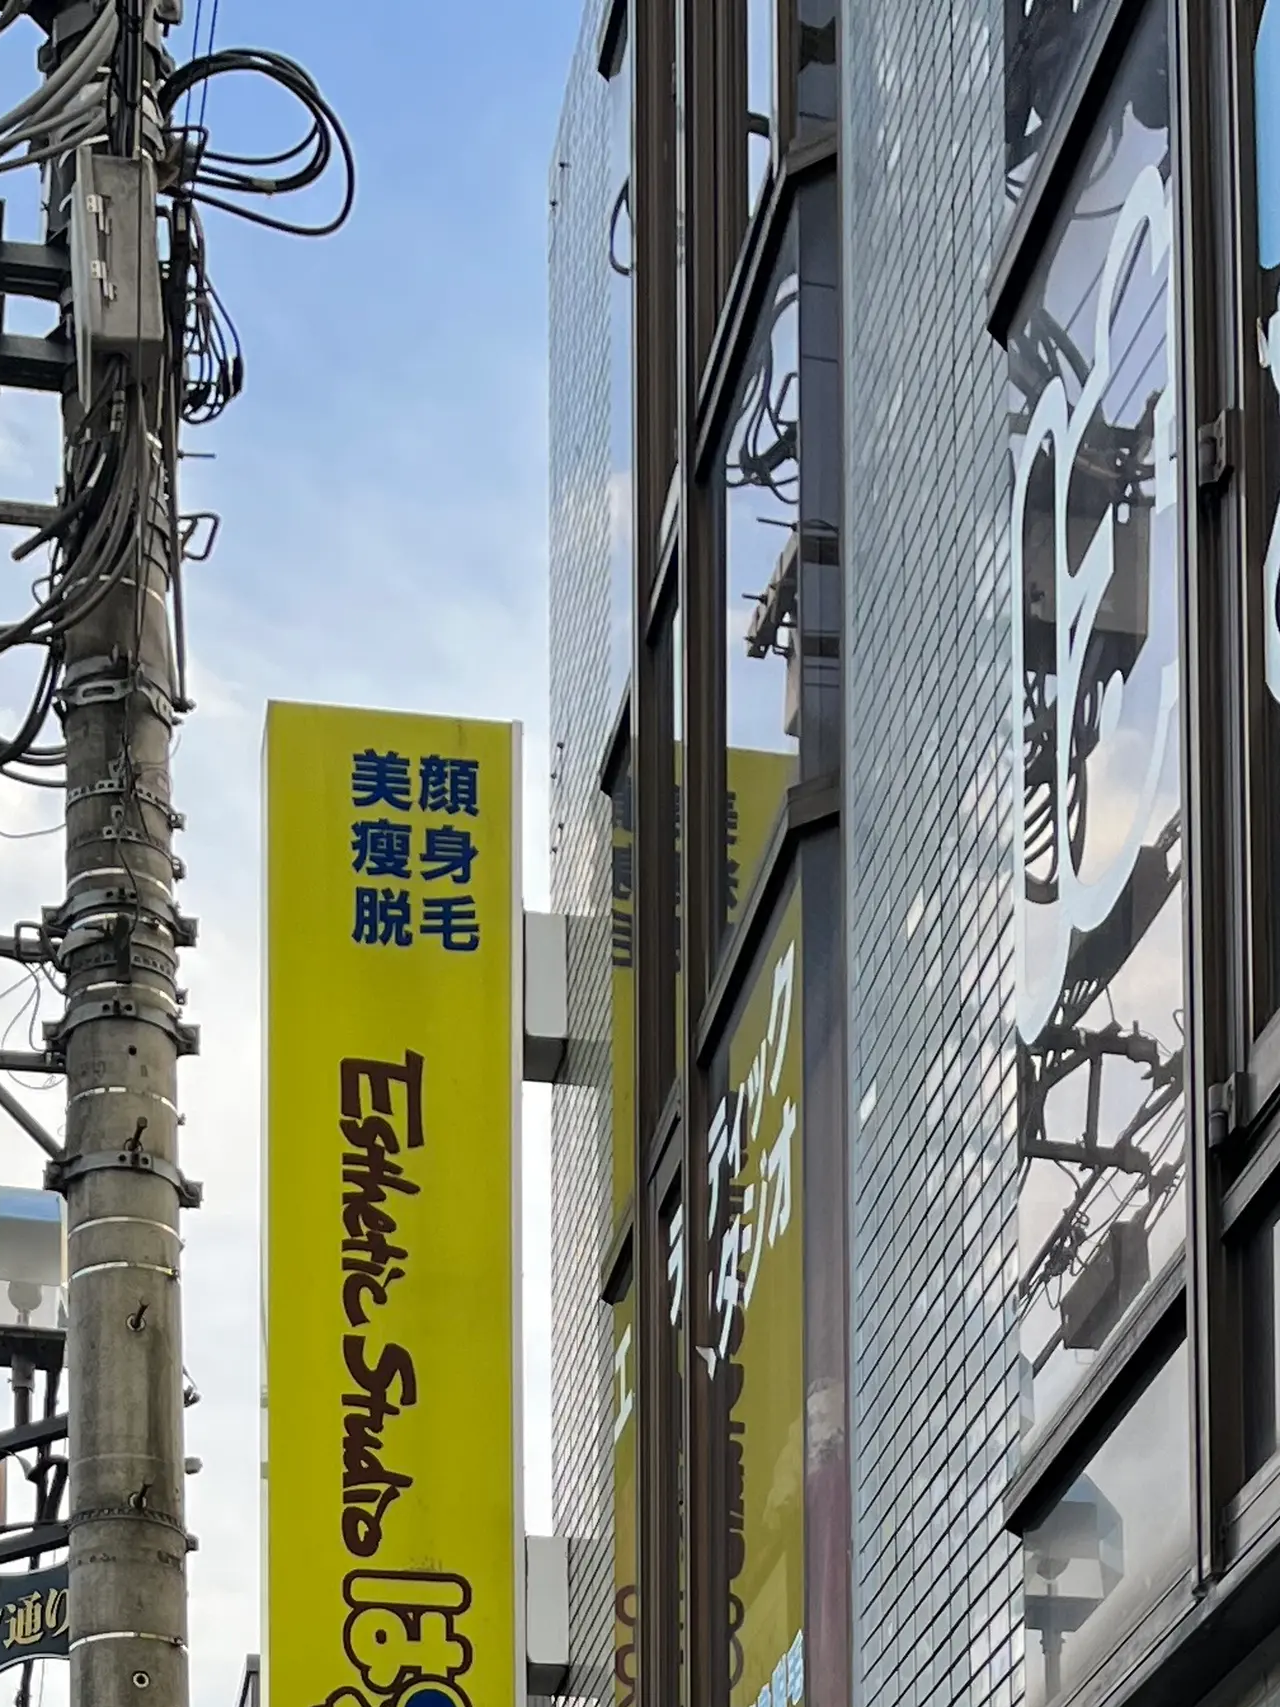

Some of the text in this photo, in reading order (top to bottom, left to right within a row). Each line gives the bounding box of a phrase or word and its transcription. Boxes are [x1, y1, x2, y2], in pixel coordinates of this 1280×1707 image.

[351, 748, 480, 816] 美顔
[351, 886, 480, 952] 脱毛
[338, 1048, 425, 1327] Esthetic
[341, 1333, 417, 1557] Studio
